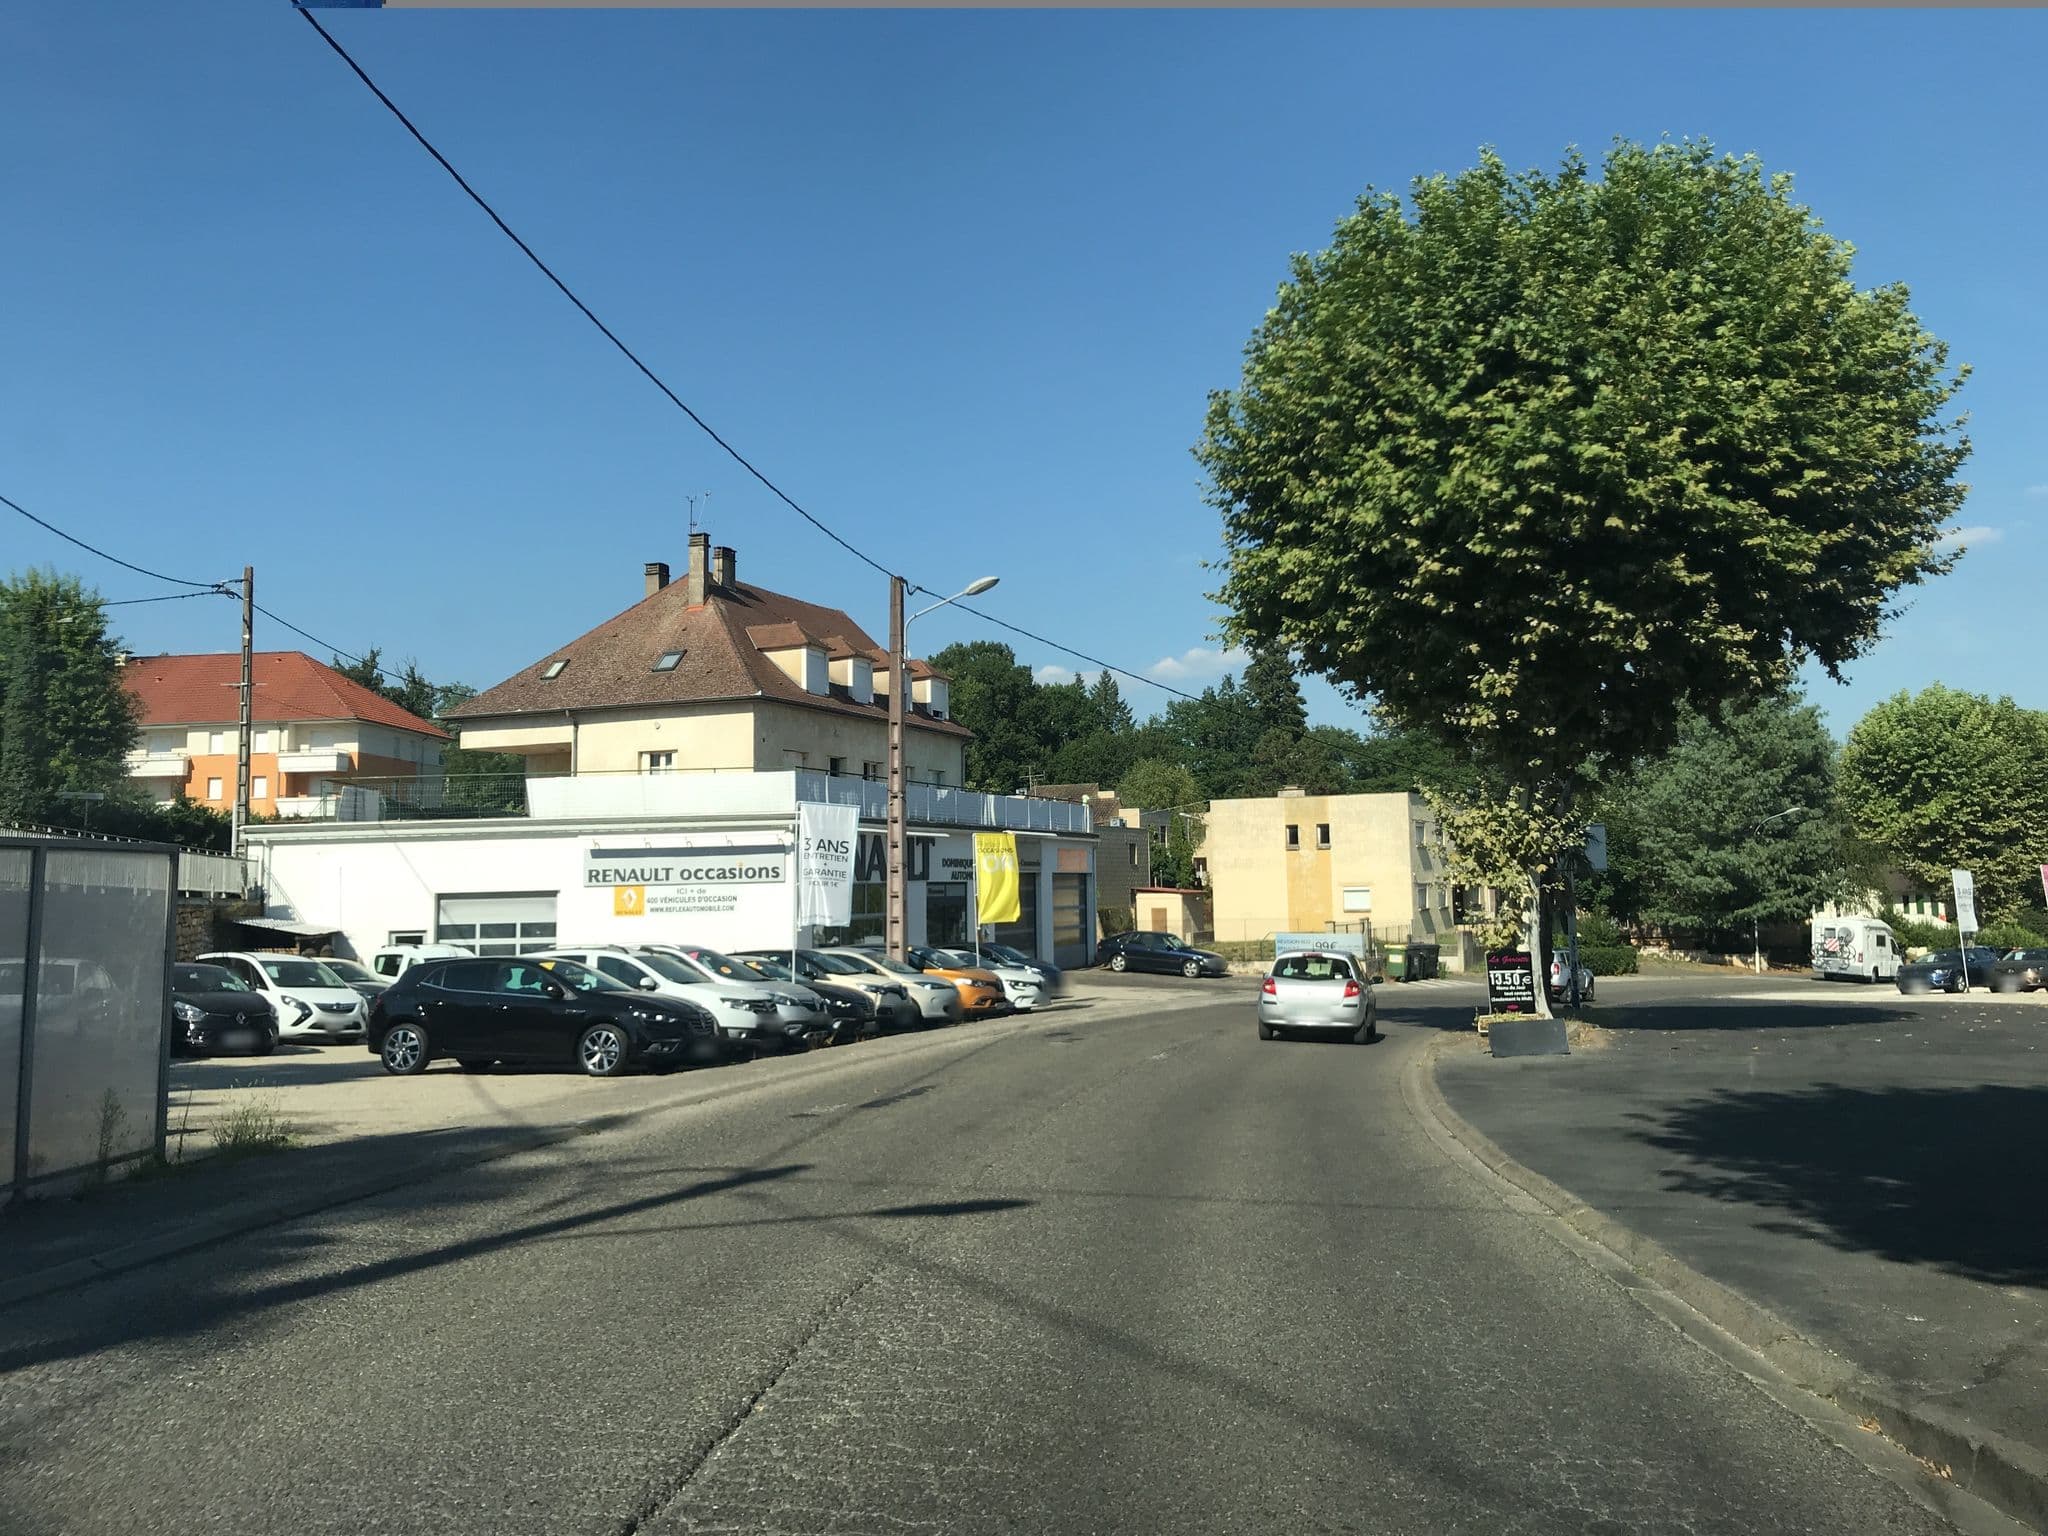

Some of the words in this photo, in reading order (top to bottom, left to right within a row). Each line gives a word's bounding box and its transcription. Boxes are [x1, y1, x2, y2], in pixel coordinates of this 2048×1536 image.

[804, 838, 812, 851] 3
[816, 838, 849, 854] ANS
[803, 852, 849, 863] ENTRETIEN
[588, 867, 674, 883] RENAULT
[679, 862, 781, 882] occasions
[803, 867, 848, 879] GARANTIE
[676, 887, 688, 895] ICI
[697, 887, 707, 895] de
[660, 895, 697, 904] VÉHICULES
[698, 895, 738, 903] D'OCCASION
